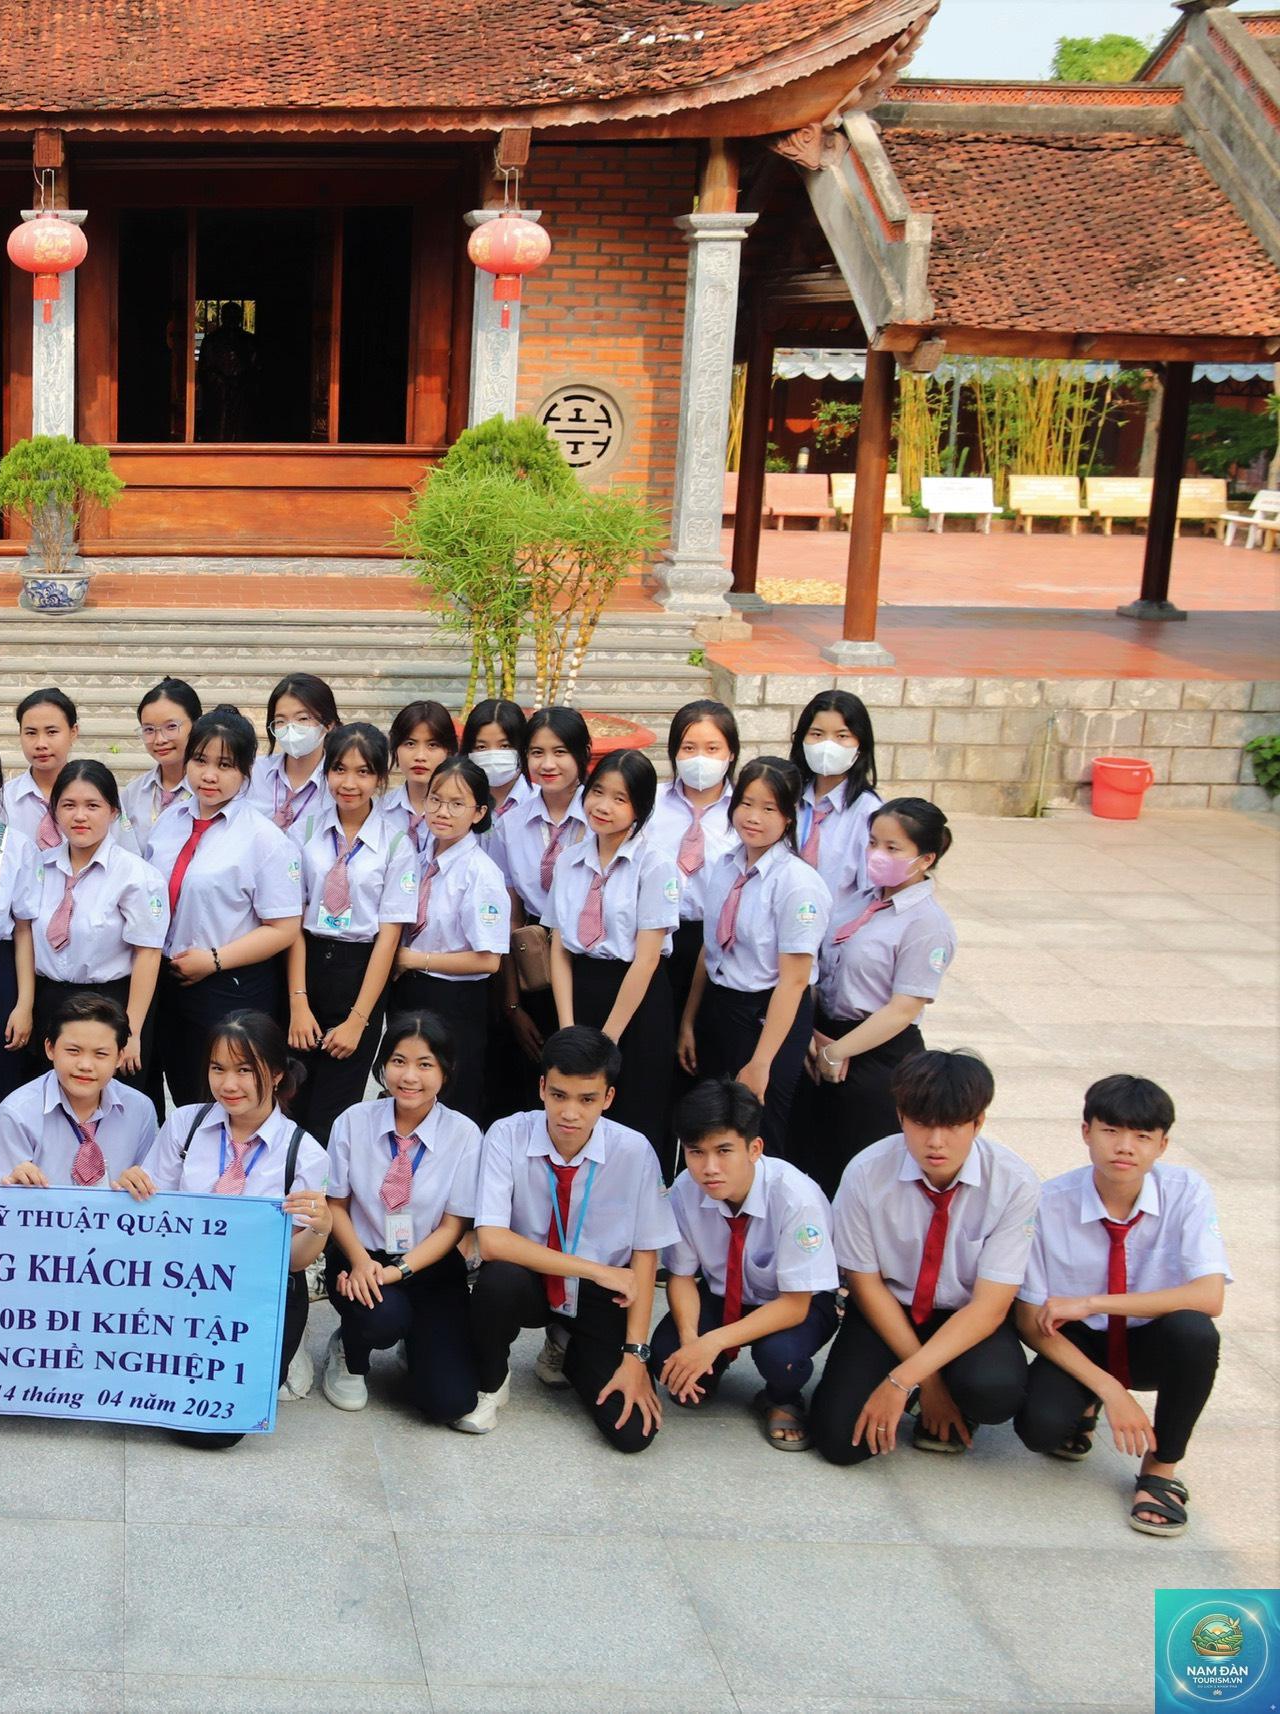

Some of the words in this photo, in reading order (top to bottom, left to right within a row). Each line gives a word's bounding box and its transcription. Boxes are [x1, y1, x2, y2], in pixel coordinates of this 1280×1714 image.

[17, 1207, 109, 1233] THUẬT
[117, 1211, 193, 1237] QUẬN
[202, 1219, 227, 1236] 12
[28, 1248, 152, 1286] KHÁCH
[163, 1261, 236, 1297] SẠN
[47, 1310, 80, 1331] ĐI
[92, 1308, 175, 1336] KIẾN
[184, 1315, 249, 1346] TẬP
[94, 1348, 225, 1384] NGHIỆP
[235, 1363, 244, 1384] 1
[22, 1386, 84, 1409] tháng
[98, 1389, 123, 1407] 04
[129, 1393, 176, 1412] năm
[183, 1398, 234, 1419] 2023
